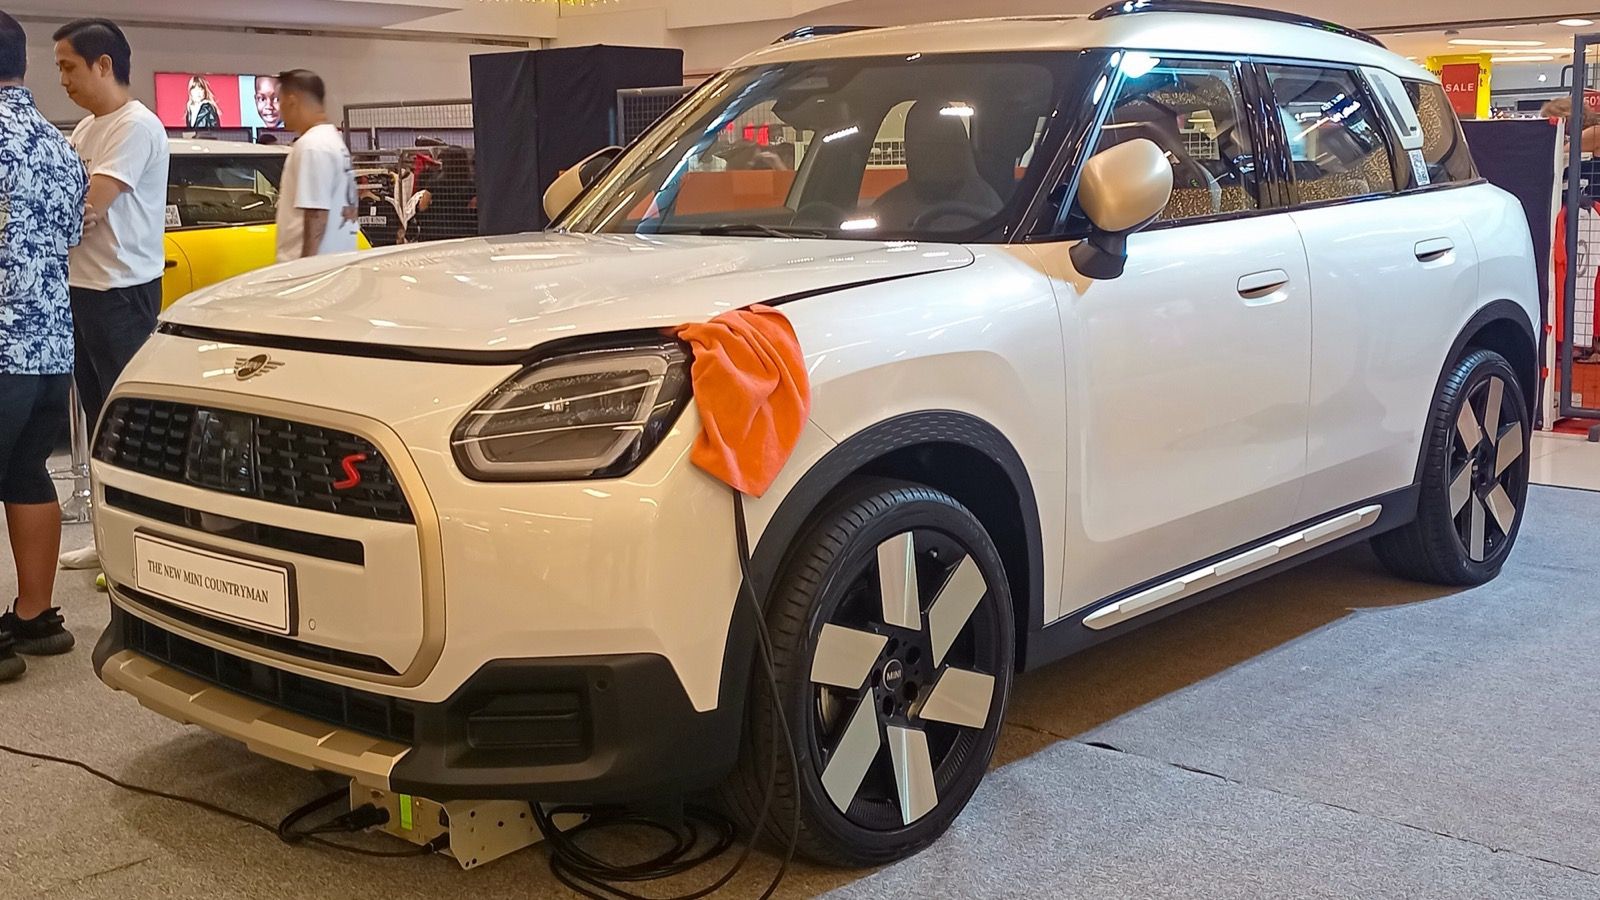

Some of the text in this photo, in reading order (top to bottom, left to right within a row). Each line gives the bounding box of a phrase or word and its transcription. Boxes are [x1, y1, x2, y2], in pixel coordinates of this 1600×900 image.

[1445, 83, 1475, 93] SALE
[333, 453, 367, 489] S
[148, 559, 269, 603] THE NEW MINI COUNTRYMAN
[887, 669, 902, 681] MINI
